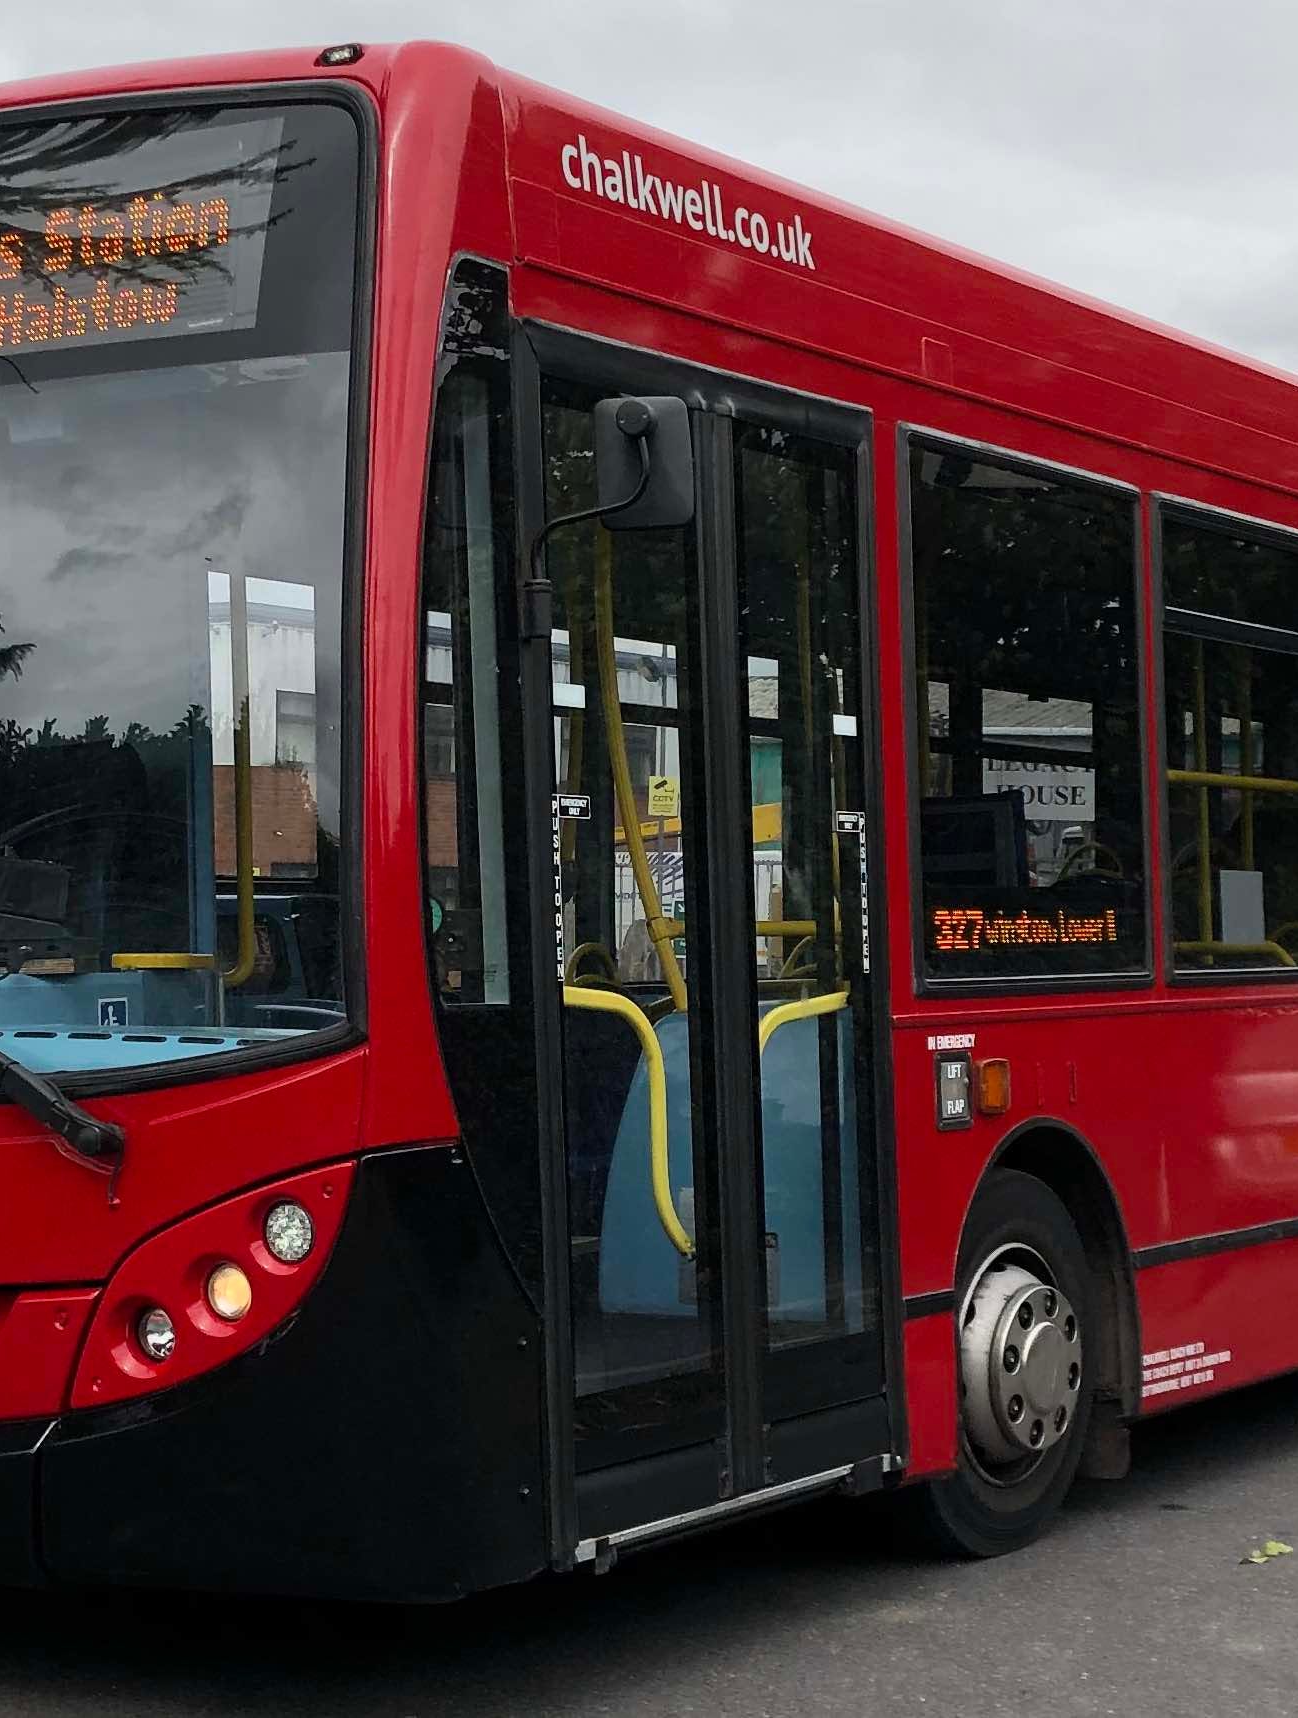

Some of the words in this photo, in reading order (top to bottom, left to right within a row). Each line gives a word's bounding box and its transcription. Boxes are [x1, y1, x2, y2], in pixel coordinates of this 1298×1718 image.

[561, 134, 815, 270] chalkwell.co.uk
[44, 191, 229, 271] Station
[652, 795, 674, 803] CCTV
[934, 910, 984, 950] 327
[947, 1064, 961, 1079] LIFT
[947, 1099, 965, 1115] FLAP
